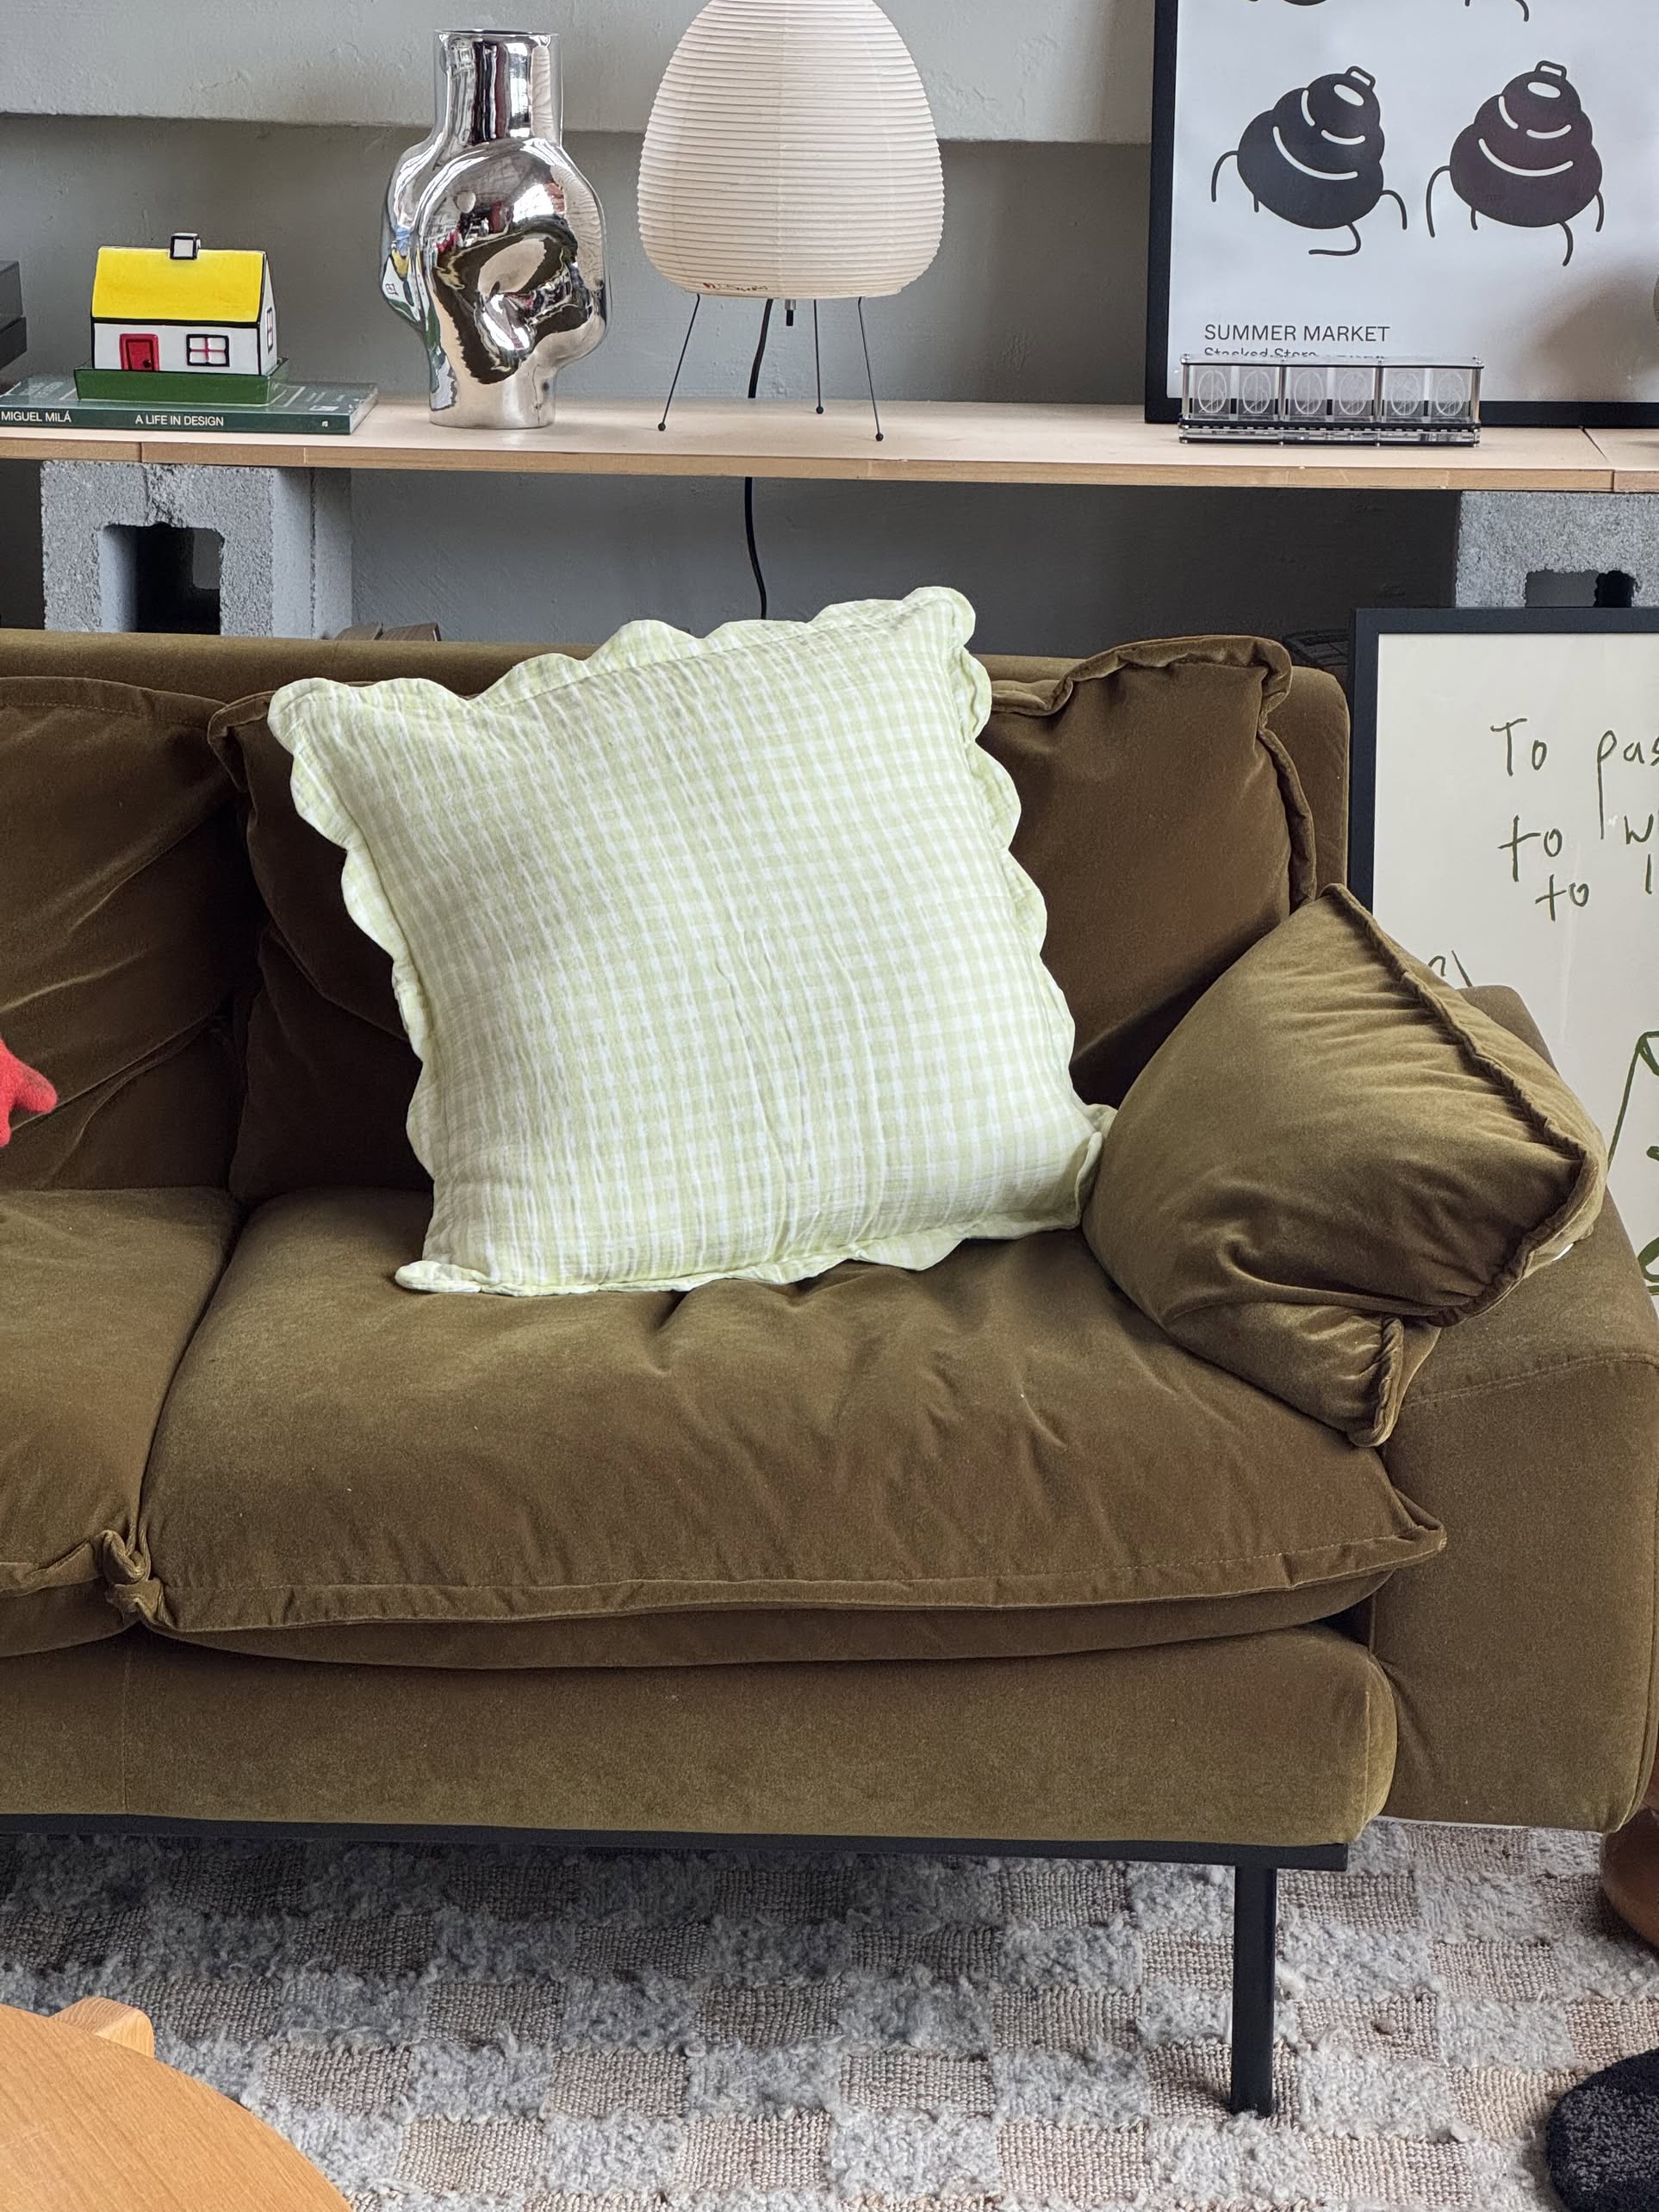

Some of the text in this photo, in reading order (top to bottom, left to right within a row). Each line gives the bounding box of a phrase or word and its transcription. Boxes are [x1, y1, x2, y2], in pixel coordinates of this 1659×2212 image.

[1204, 324, 1390, 342] SUMMER MARKET
[1, 410, 72, 423] MIGUEL MILÁ
[135, 414, 224, 426] A LIFE IN DESIGN
[1489, 718, 1547, 776] To
[1497, 814, 1563, 882] to
[1535, 873, 1589, 922] to
